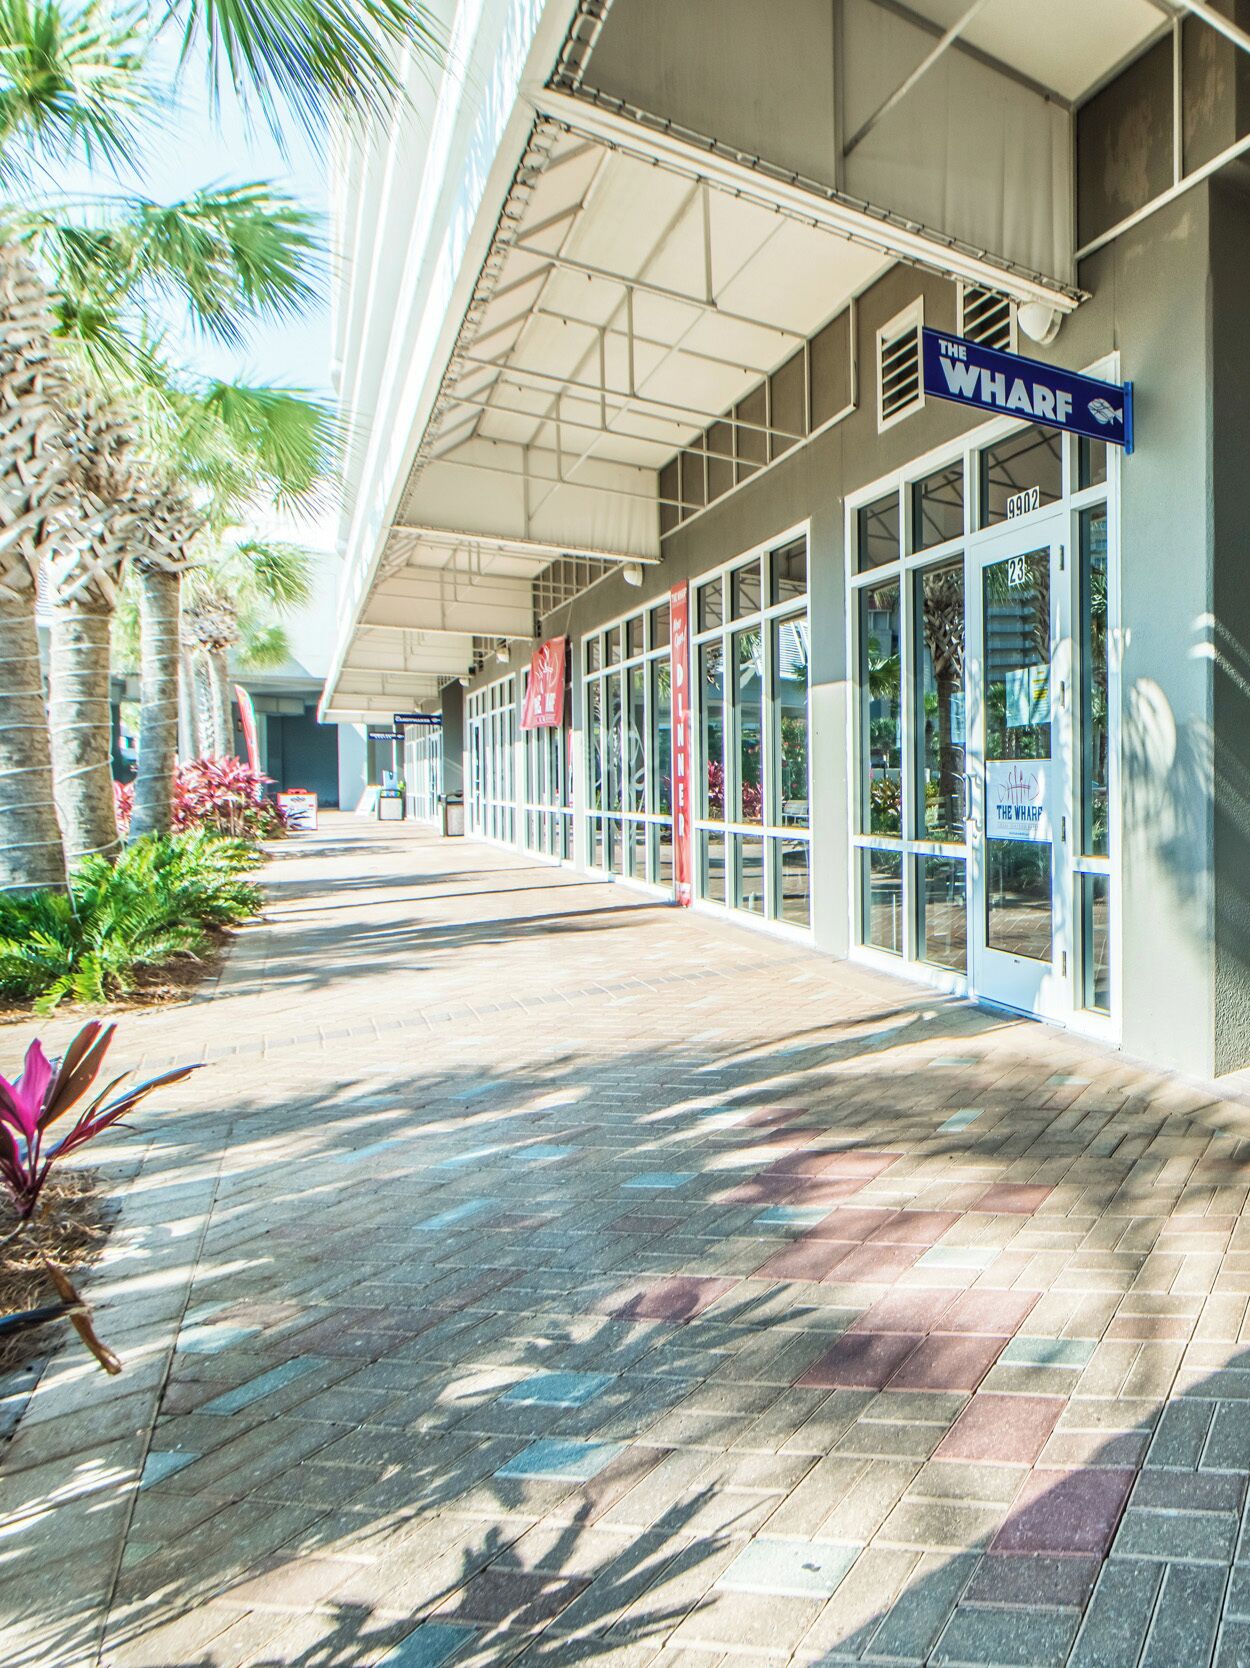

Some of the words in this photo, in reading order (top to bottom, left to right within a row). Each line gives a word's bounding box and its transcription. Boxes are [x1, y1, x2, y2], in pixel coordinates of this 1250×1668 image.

[938, 339, 967, 361] THE
[939, 356, 1073, 423] WHARF
[1008, 488, 1039, 520] 9902
[1009, 558, 1024, 584] 23
[676, 663, 685, 837] DINNER
[997, 805, 1012, 820] THE
[1015, 805, 1043, 821] WHARF
